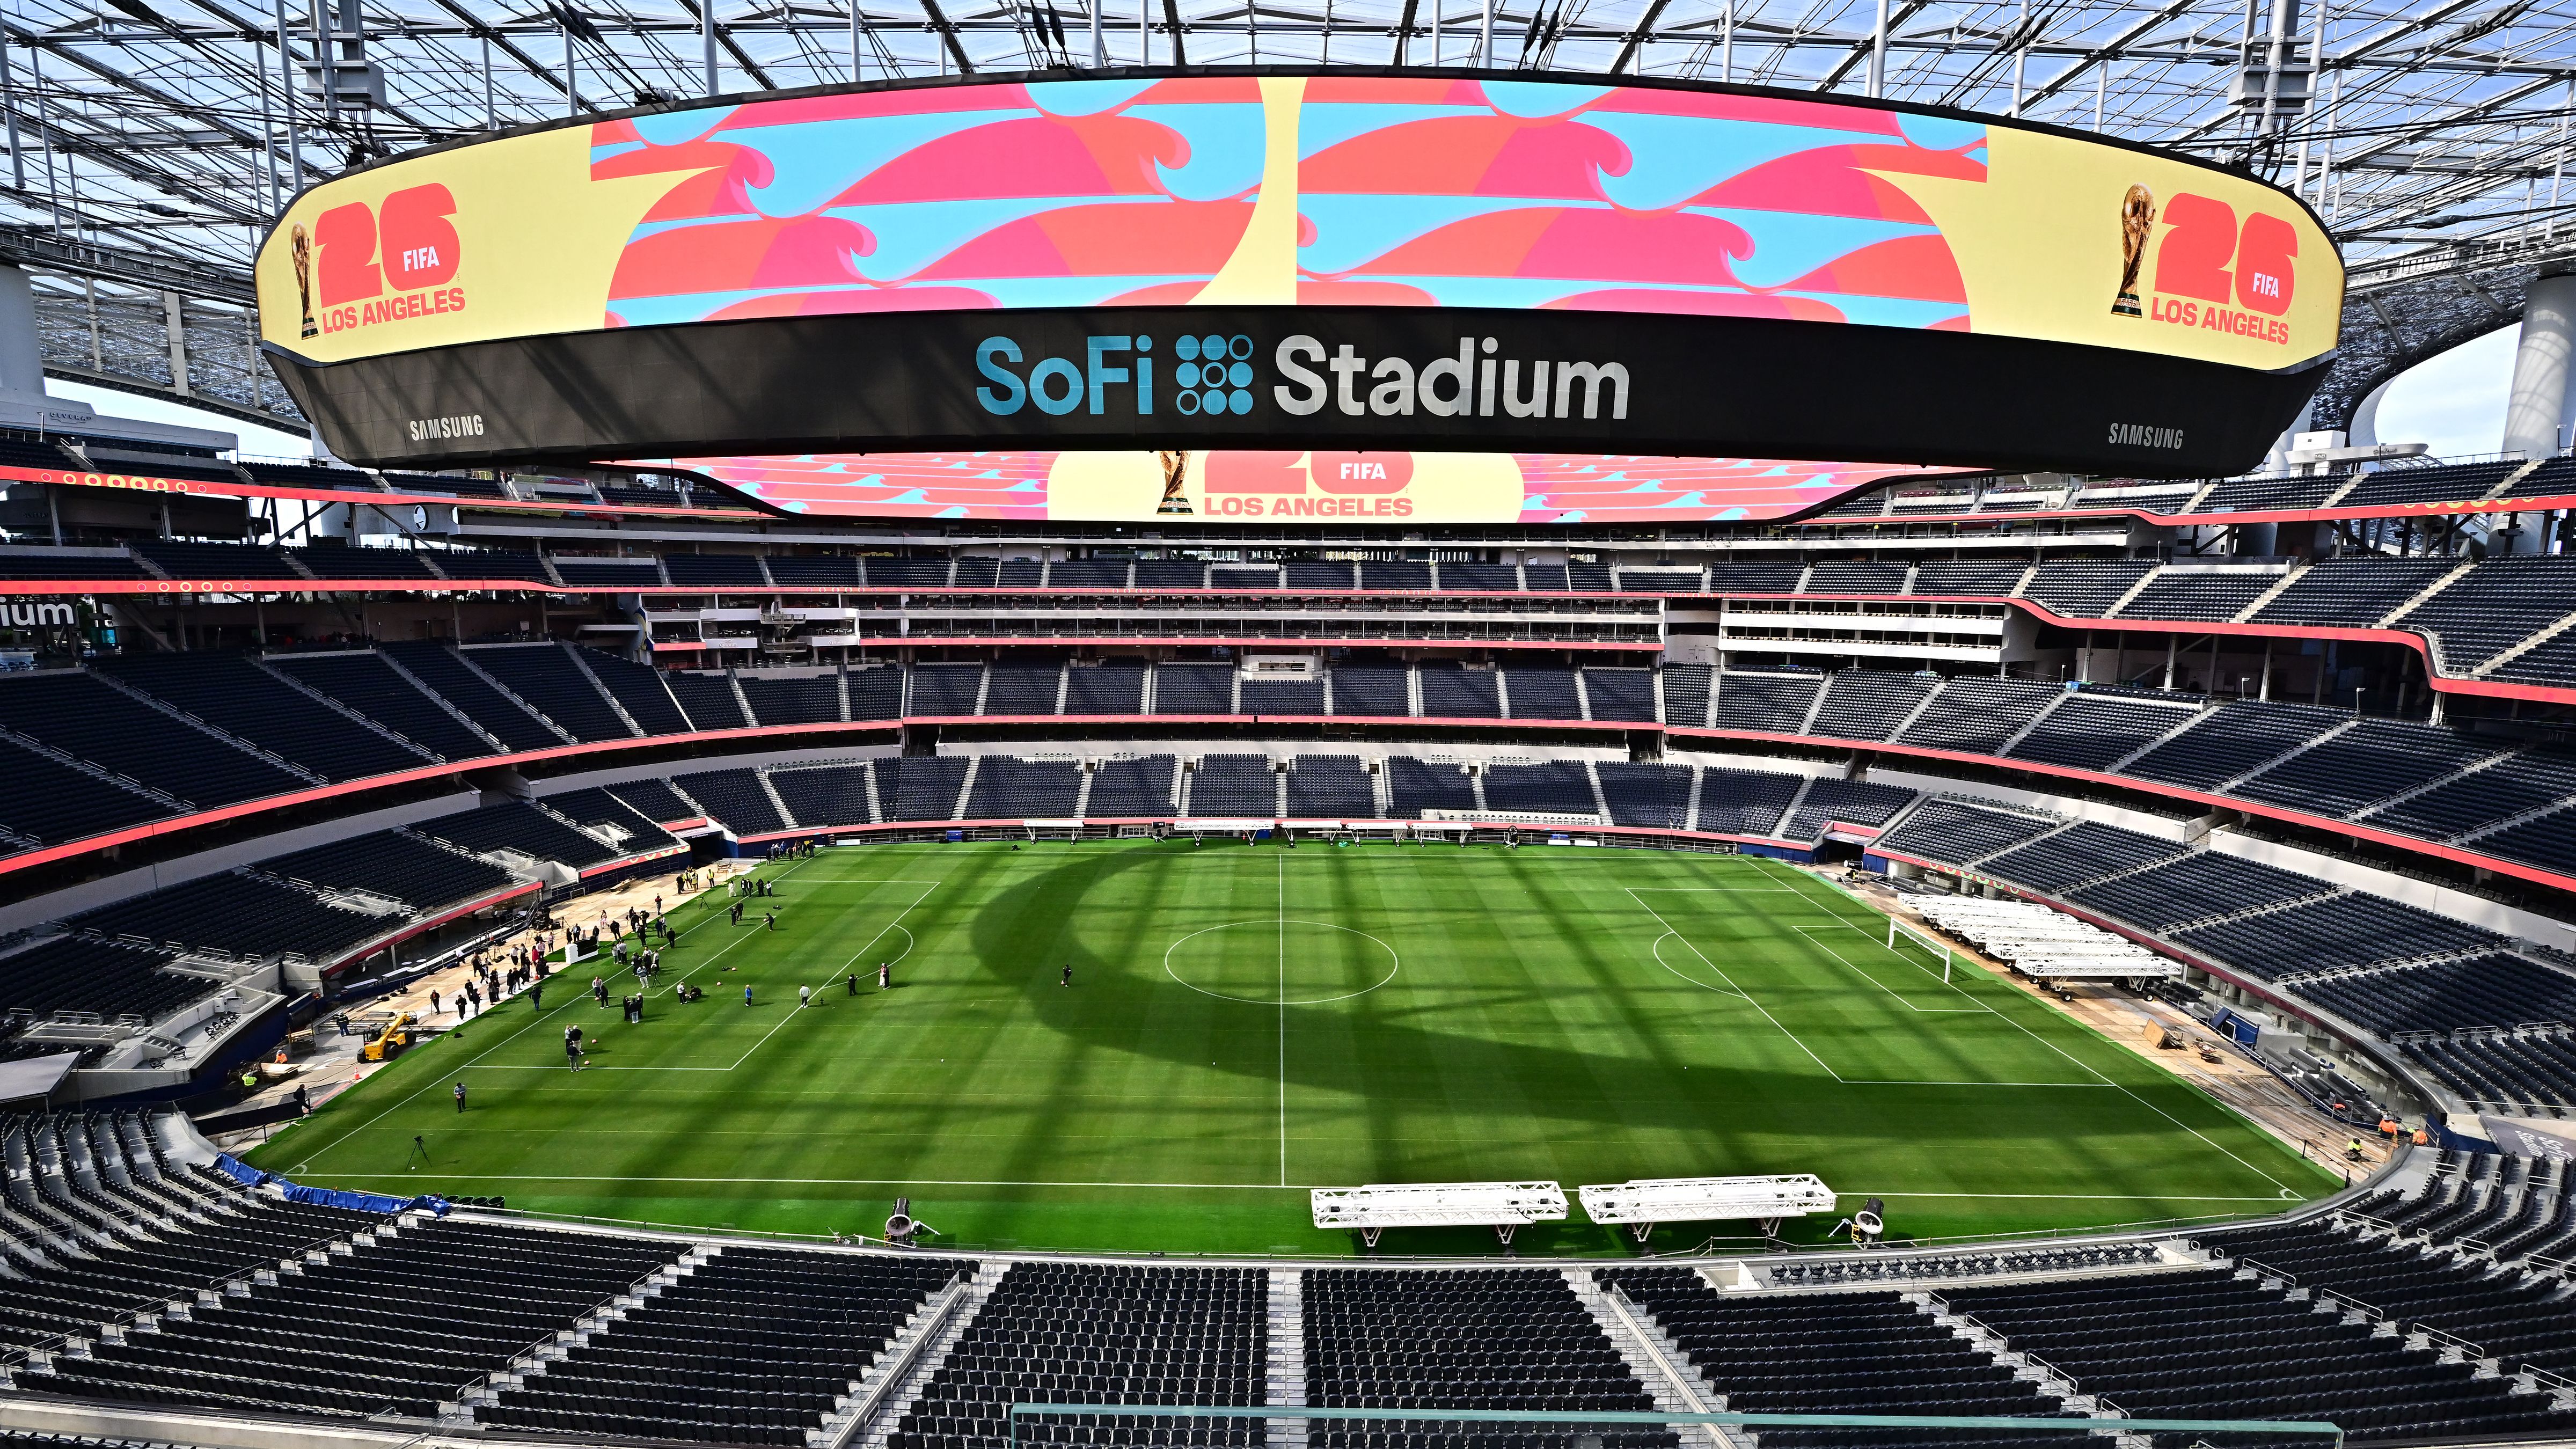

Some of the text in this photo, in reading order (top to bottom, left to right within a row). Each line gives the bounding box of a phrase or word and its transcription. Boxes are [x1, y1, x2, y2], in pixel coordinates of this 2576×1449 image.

[314, 182, 460, 308] 26
[2154, 192, 2298, 317] 26
[403, 246, 440, 272] FIFA
[2252, 272, 2279, 298] FIFA
[322, 287, 466, 334] LOS ANGELES
[2151, 297, 2289, 345] LOS ANGELES
[976, 334, 1630, 419] SoFi Stadium
[410, 414, 484, 441] SAMSUNG
[2109, 422, 2184, 449] SAMSUNG
[1341, 463, 1387, 479] FIFA
[1205, 497, 1413, 516] LOS ANGELES
